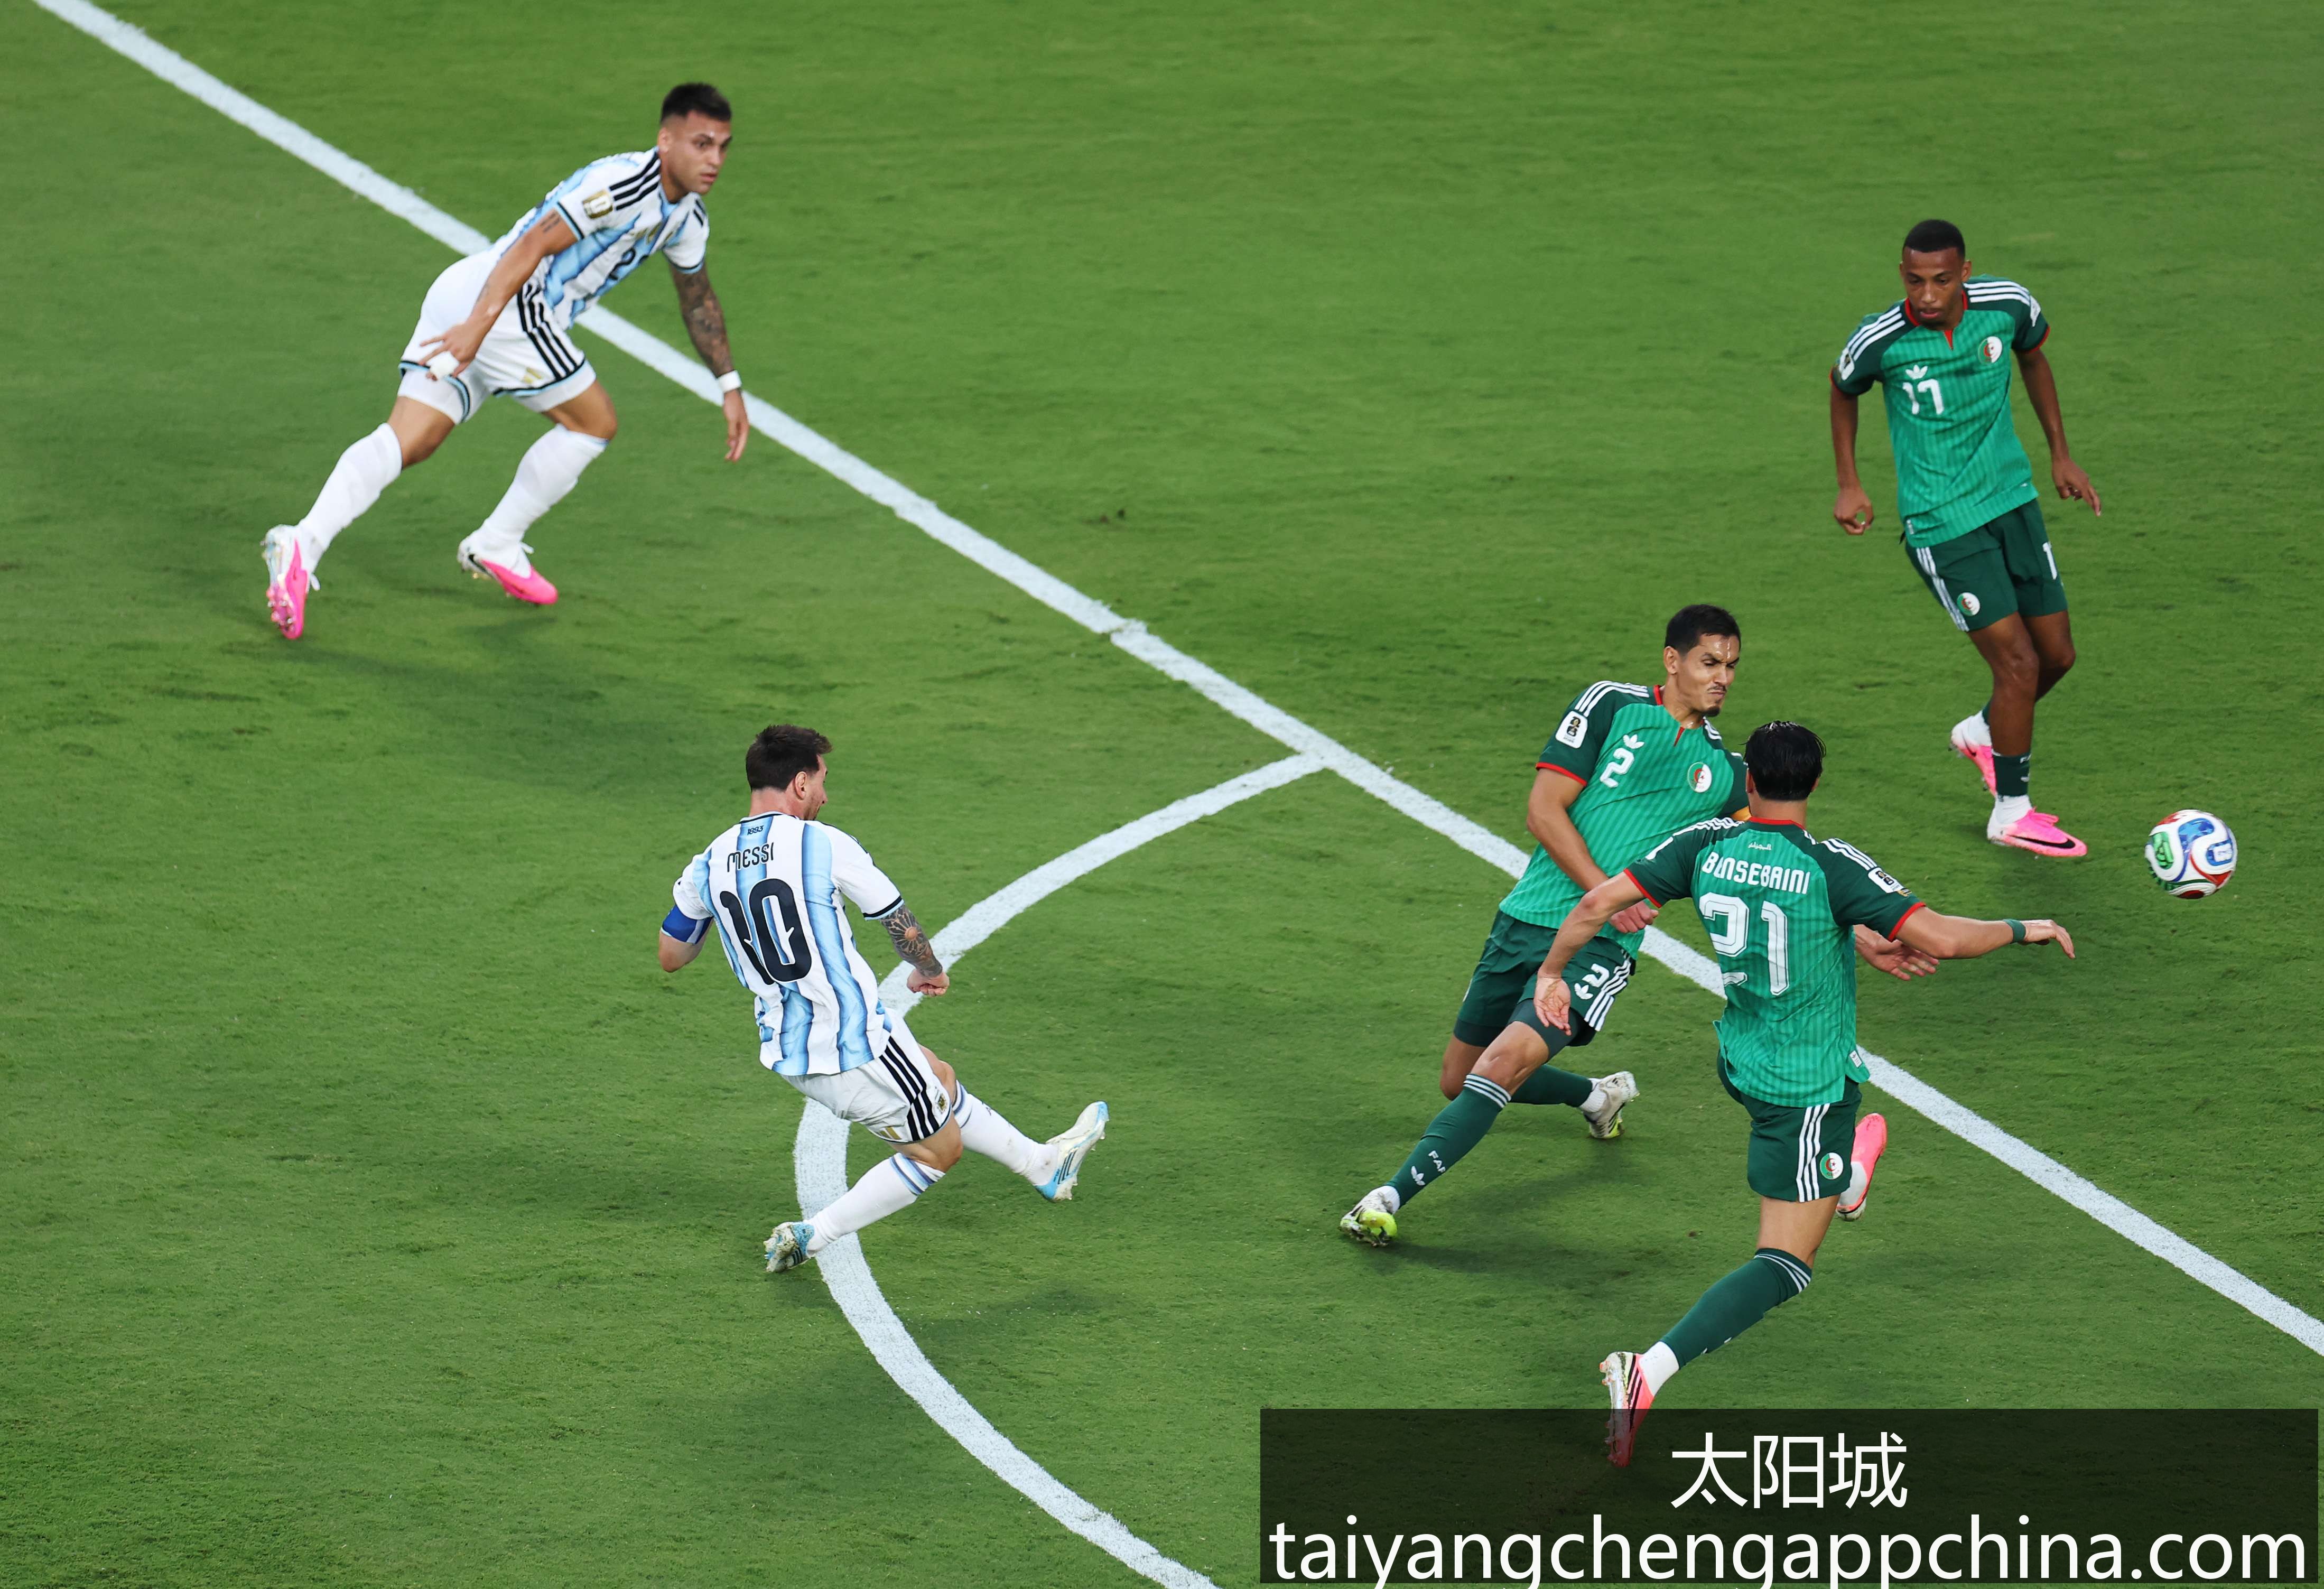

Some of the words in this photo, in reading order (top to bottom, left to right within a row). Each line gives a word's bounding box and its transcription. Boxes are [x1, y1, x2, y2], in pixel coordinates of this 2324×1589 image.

[608, 247, 649, 281] 2
[1902, 378, 1944, 415] 17
[1600, 747, 1635, 788] 2
[747, 825, 764, 835] 1893
[727, 842, 774, 872] MESSI
[719, 878, 812, 985] 10
[1699, 891, 1790, 996] 21
